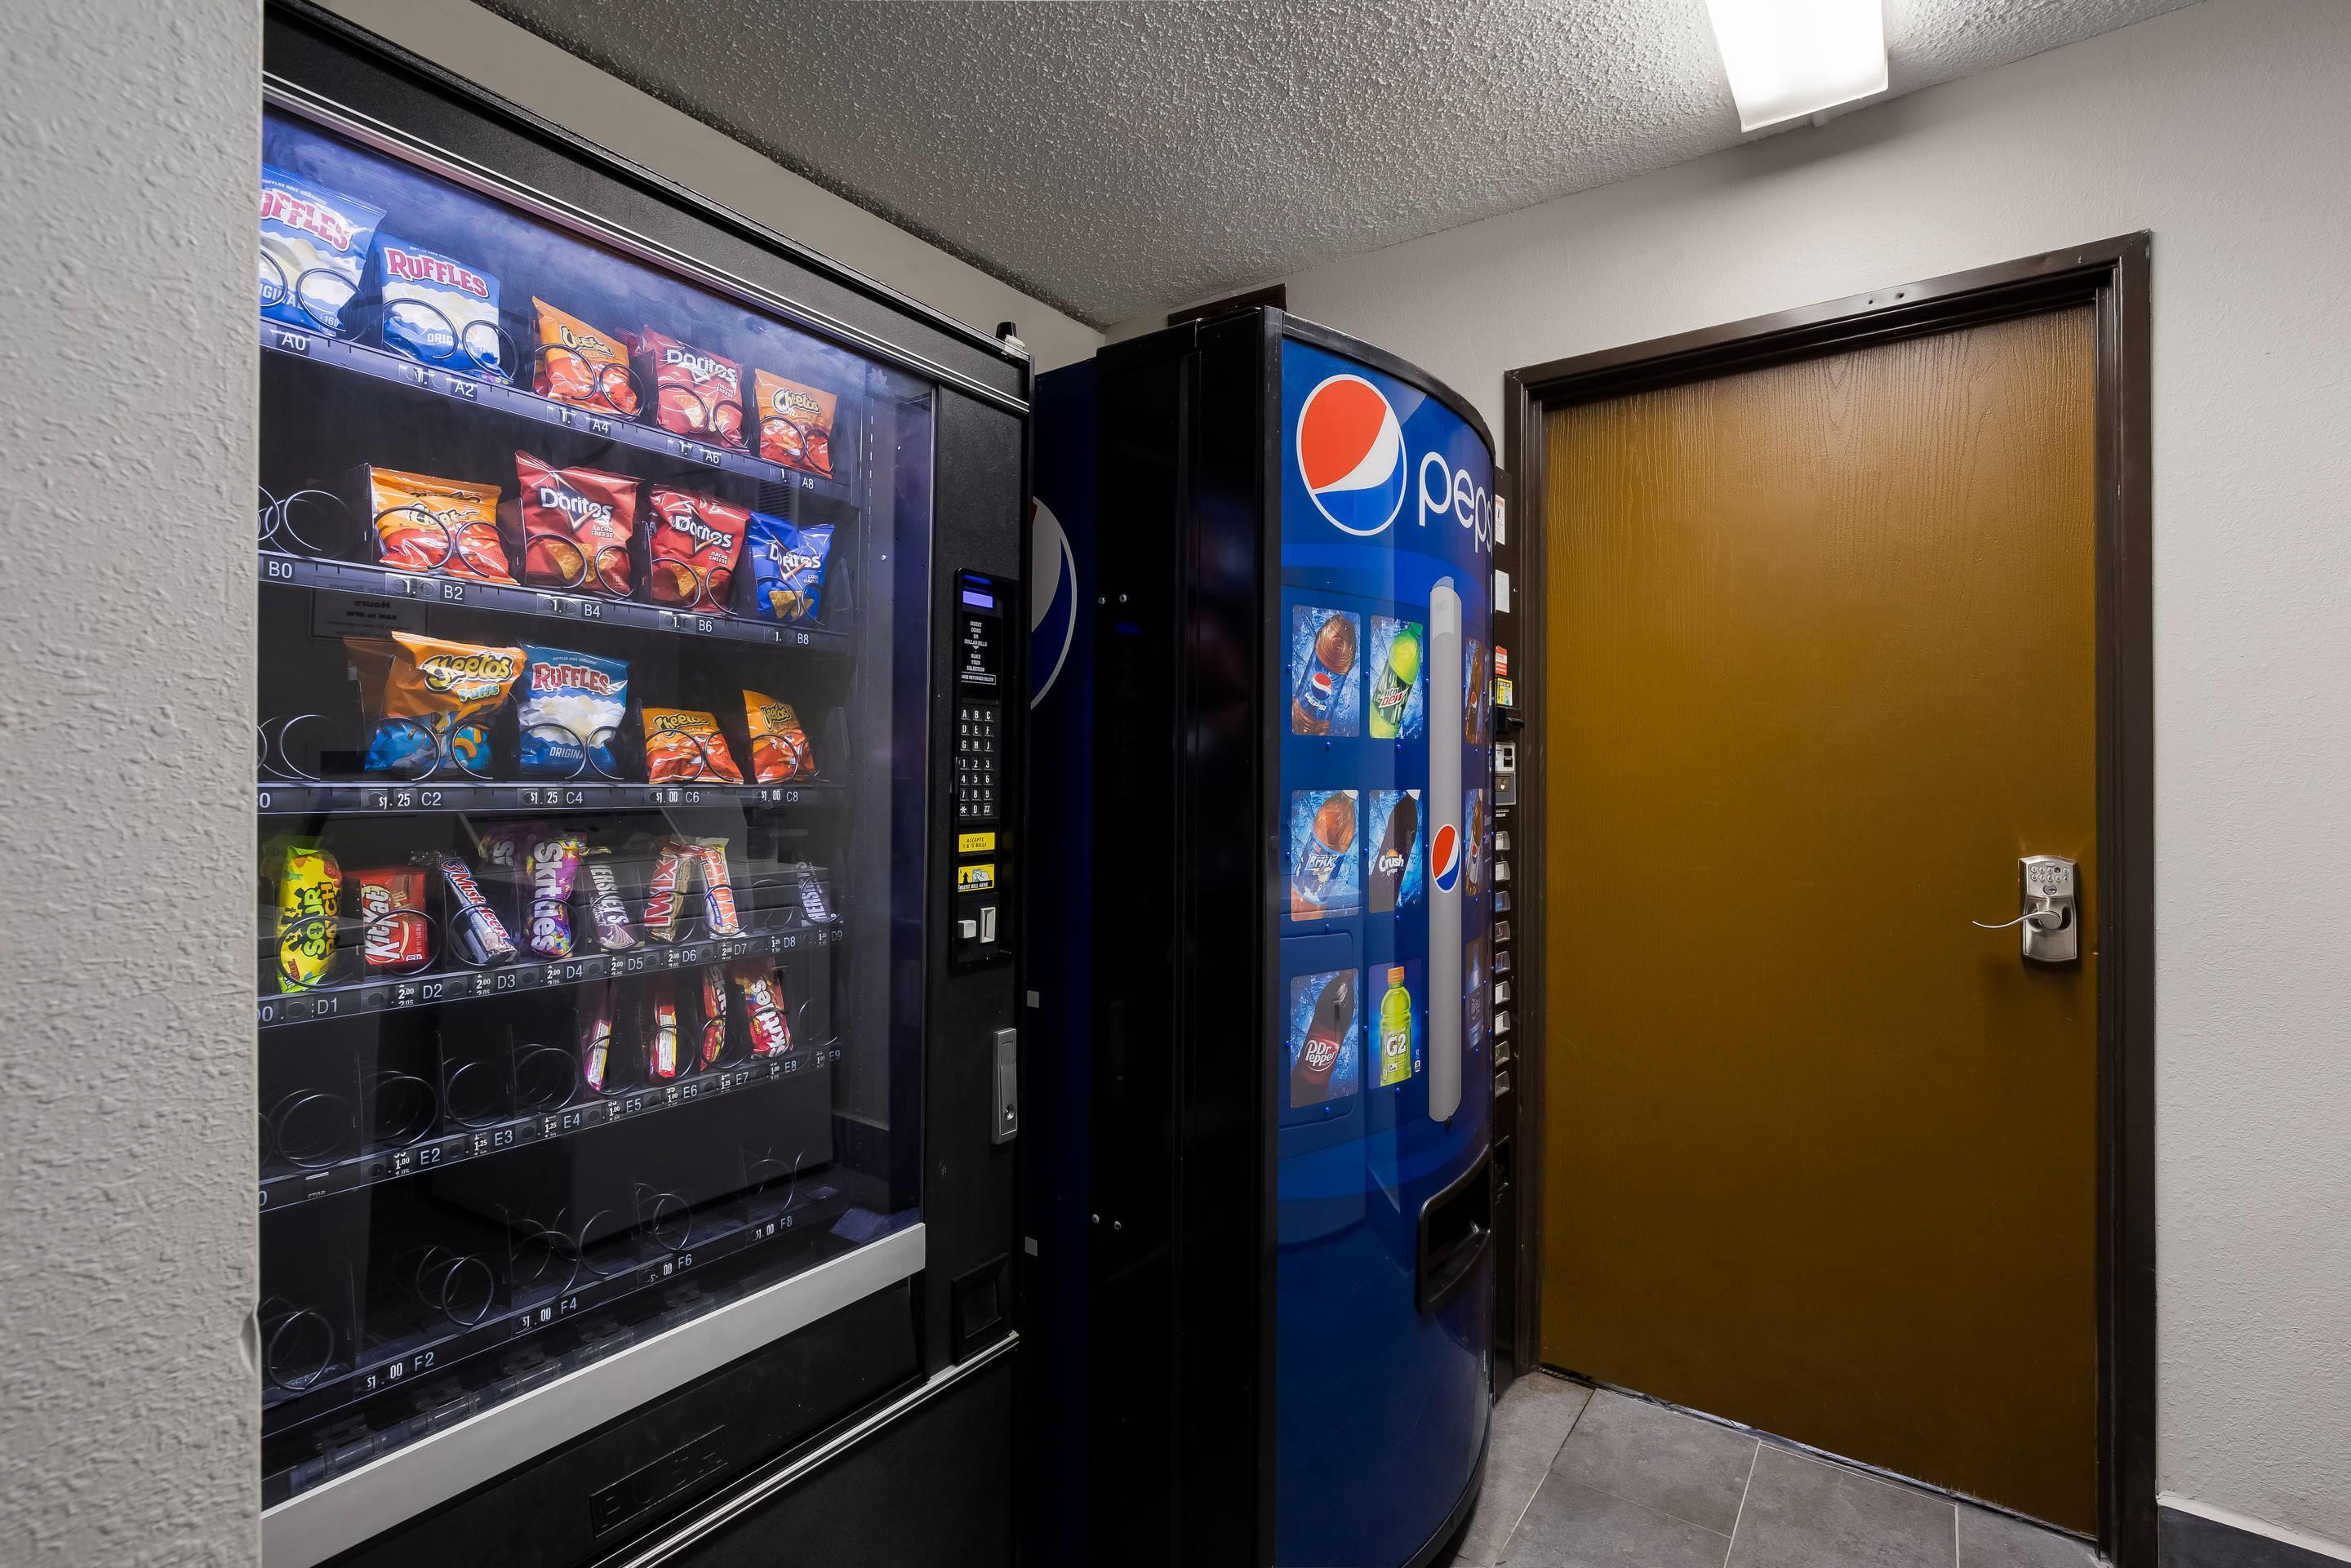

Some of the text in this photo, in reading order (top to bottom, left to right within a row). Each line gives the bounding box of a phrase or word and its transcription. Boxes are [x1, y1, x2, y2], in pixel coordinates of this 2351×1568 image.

[384, 247, 489, 299] RUFFLES
[282, 332, 306, 351] A0
[667, 349, 738, 382] Doritos
[455, 380, 475, 398] A2
[772, 389, 821, 414] Cheetos
[592, 420, 609, 434] A4
[705, 451, 720, 464] A6
[802, 476, 815, 490] A8
[540, 487, 613, 520] Doritos
[590, 531, 614, 539] CHEESE
[591, 526, 614, 534] NACHO
[674, 515, 732, 549] Doritos
[709, 555, 727, 565] CHEESE
[711, 551, 728, 560] NACHO
[769, 543, 822, 569] Doritos
[268, 561, 294, 580] B0
[443, 584, 464, 601] B2
[584, 604, 601, 618] B4
[699, 620, 713, 633] B6
[797, 633, 810, 645] B8
[532, 662, 611, 695] RUFFLES
[457, 684, 500, 702] Puffs
[1304, 692, 1327, 711] PEPSI
[420, 792, 442, 806] C2
[567, 791, 584, 805] C4
[685, 791, 700, 803] C6
[786, 791, 798, 802] C8
[442, 861, 466, 873] 3
[1306, 855, 1338, 871] Brisk
[1378, 855, 1405, 873] Crush
[531, 842, 564, 952] Skittles
[303, 887, 325, 957] SOUR
[784, 936, 796, 948] D8
[831, 930, 842, 942] D9
[668, 949, 696, 962] 2.00 D6
[722, 943, 748, 957] 2.00 D7
[611, 957, 643, 971] 2.00 D5
[548, 965, 583, 980] 2.00 D4
[476, 975, 516, 989] 2.00 D3
[398, 984, 443, 1000] 2.00 D2
[317, 997, 339, 1015] D1
[753, 979, 786, 1058] Skittles
[1305, 1039, 1337, 1067] Pepper
[1317, 1042, 1332, 1054] Dr
[1386, 1033, 1407, 1057] G2
[829, 1050, 841, 1061] E9
[784, 1060, 798, 1073] E8
[721, 1072, 749, 1090] 1.25 E7
[668, 1084, 698, 1103] 1.00 E6
[609, 1098, 642, 1117] 1.00 E5
[544, 1113, 580, 1134] 1.25 E4
[473, 1130, 513, 1152] 1.25 E3
[395, 1148, 441, 1170] 1.00 E2
[780, 1215, 793, 1230] F8
[678, 1253, 692, 1269] F6
[561, 1298, 578, 1315] F4
[415, 1351, 434, 1371] F2
